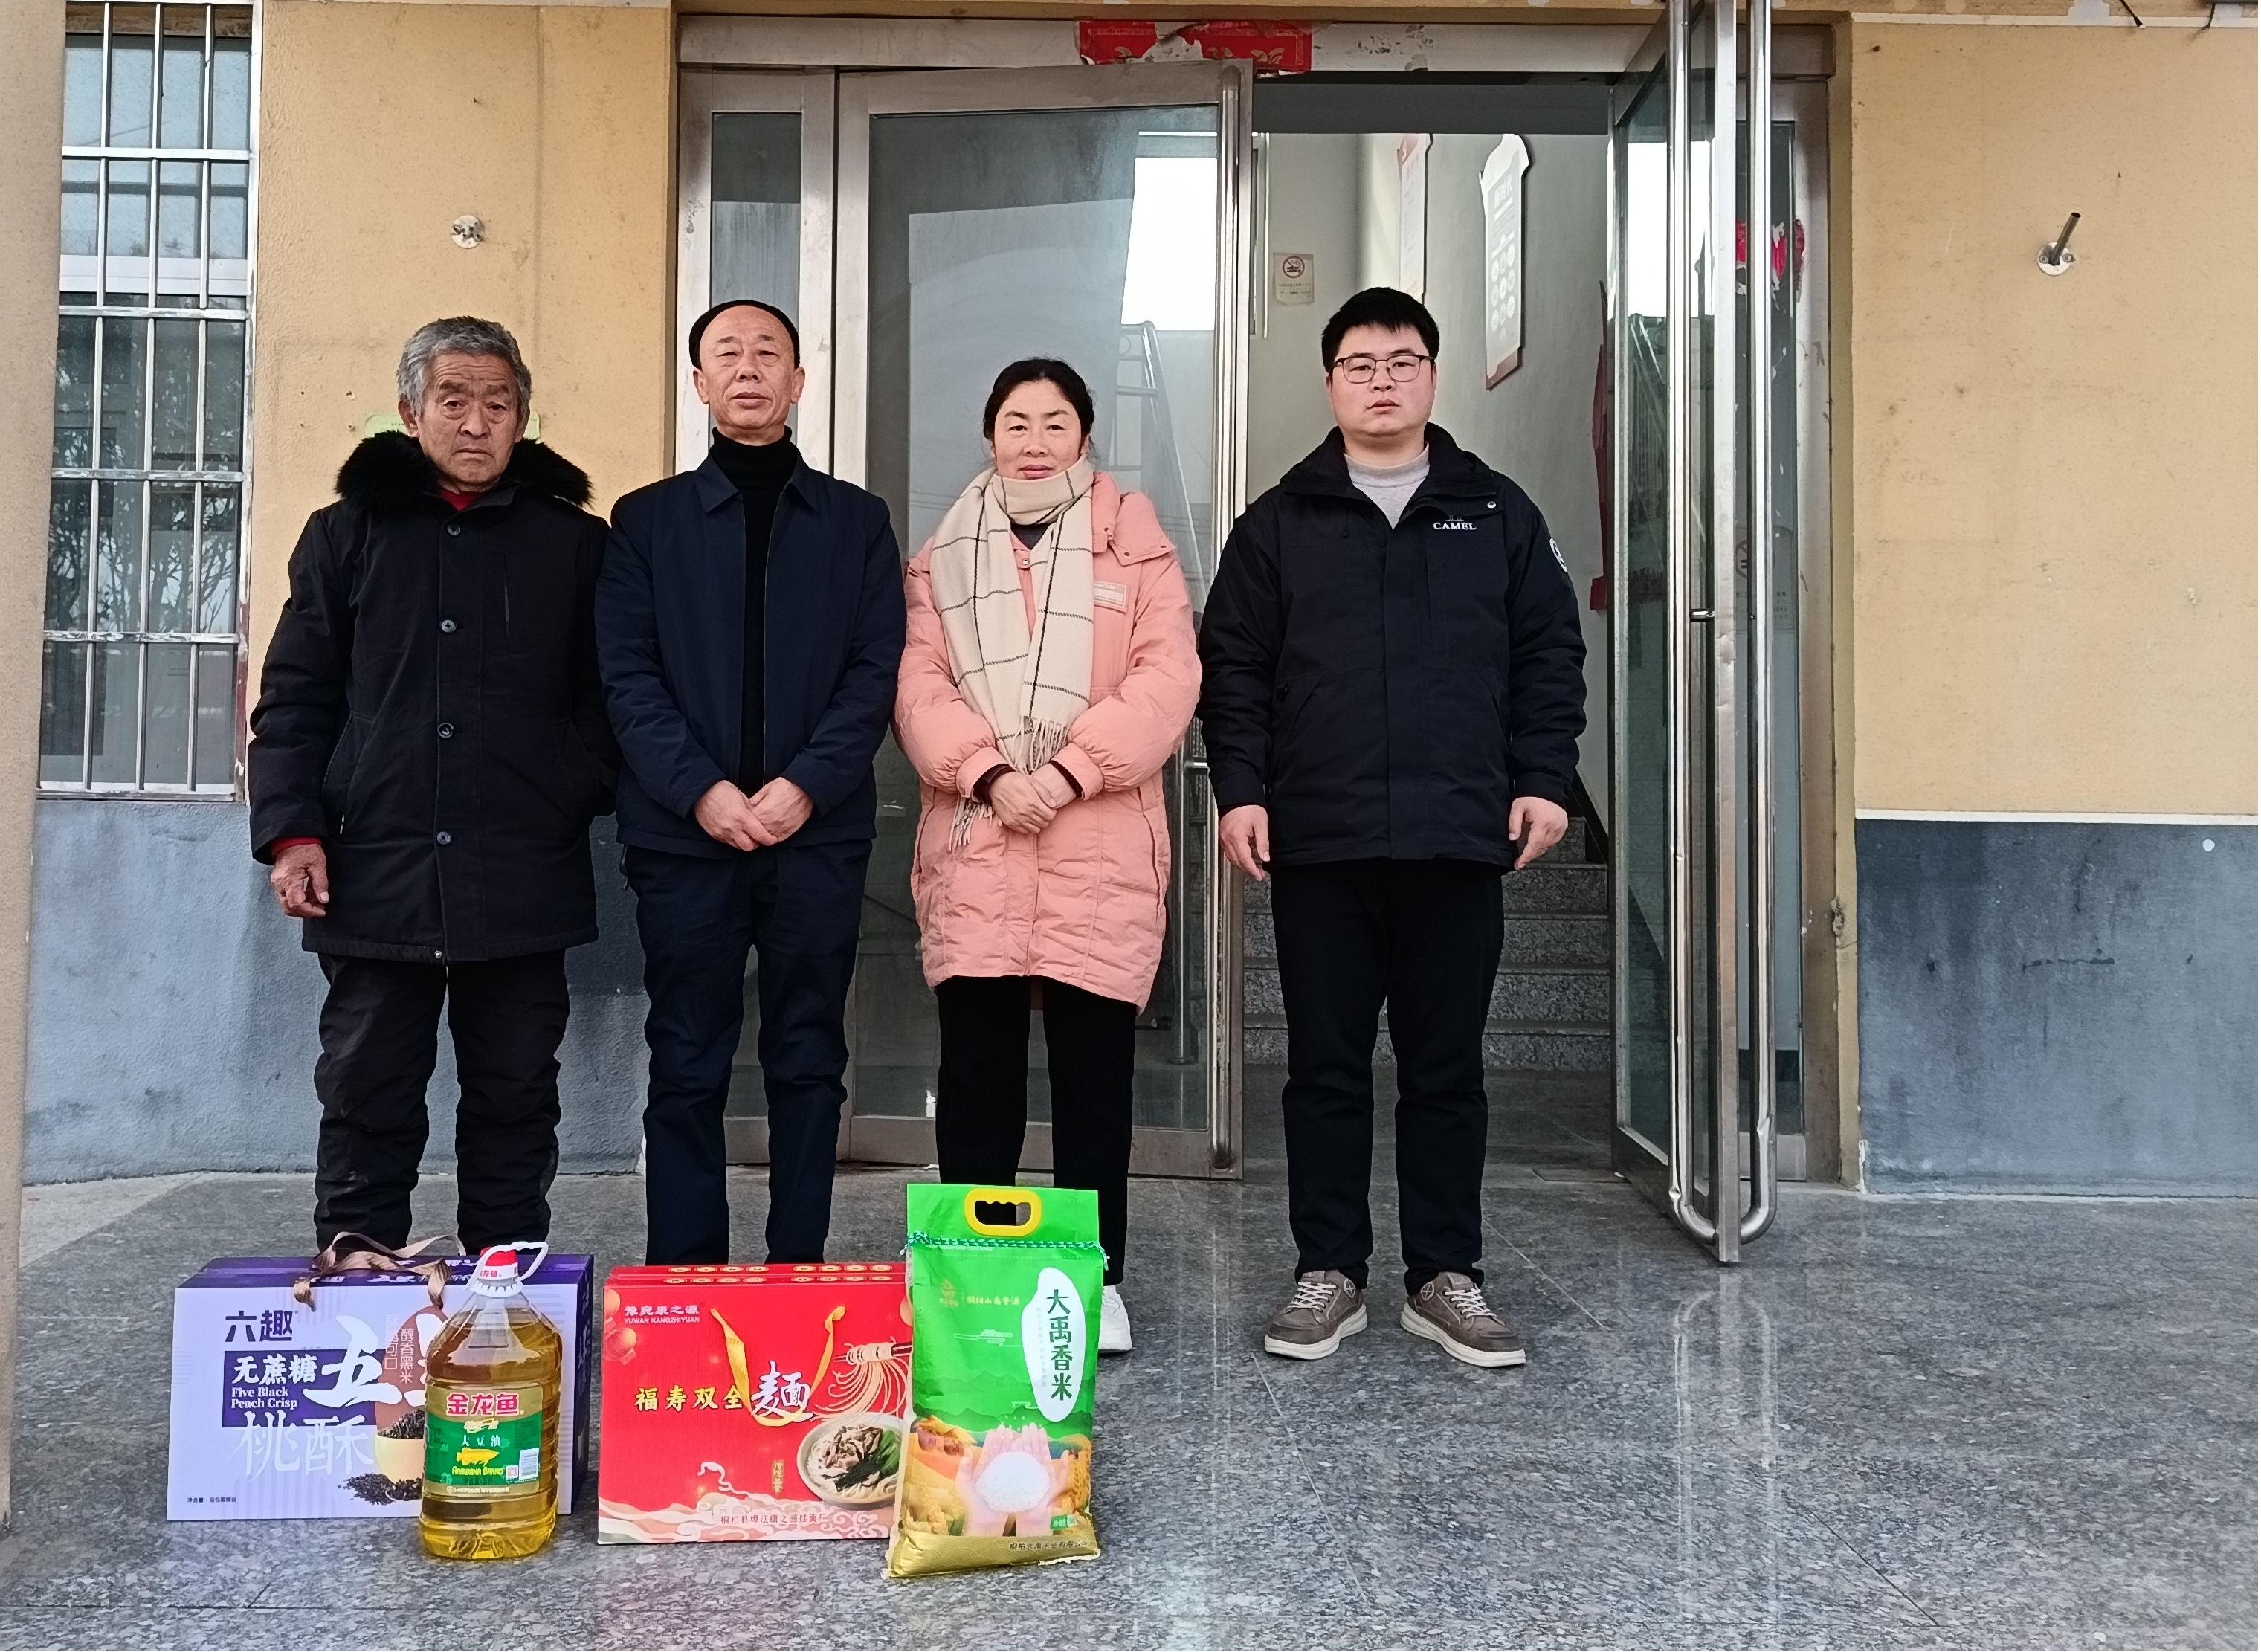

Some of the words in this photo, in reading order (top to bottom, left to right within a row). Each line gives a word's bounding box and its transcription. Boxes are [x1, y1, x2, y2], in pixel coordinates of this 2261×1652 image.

[1433, 522, 1477, 531] CAMEL
[225, 1309, 293, 1343] 六趣
[399, 1328, 415, 1384] 醇香黑米
[1045, 1288, 1073, 1401] 大禹香米
[231, 1353, 317, 1386] 无蔗糖
[231, 1387, 255, 1398] Five
[257, 1386, 289, 1398] Black
[231, 1398, 265, 1409] Peach
[267, 1398, 298, 1411] Crisp
[446, 1391, 520, 1417] 金龙鱼
[634, 1385, 744, 1413] 福寿双全
[230, 1410, 374, 1482] 桃酥
